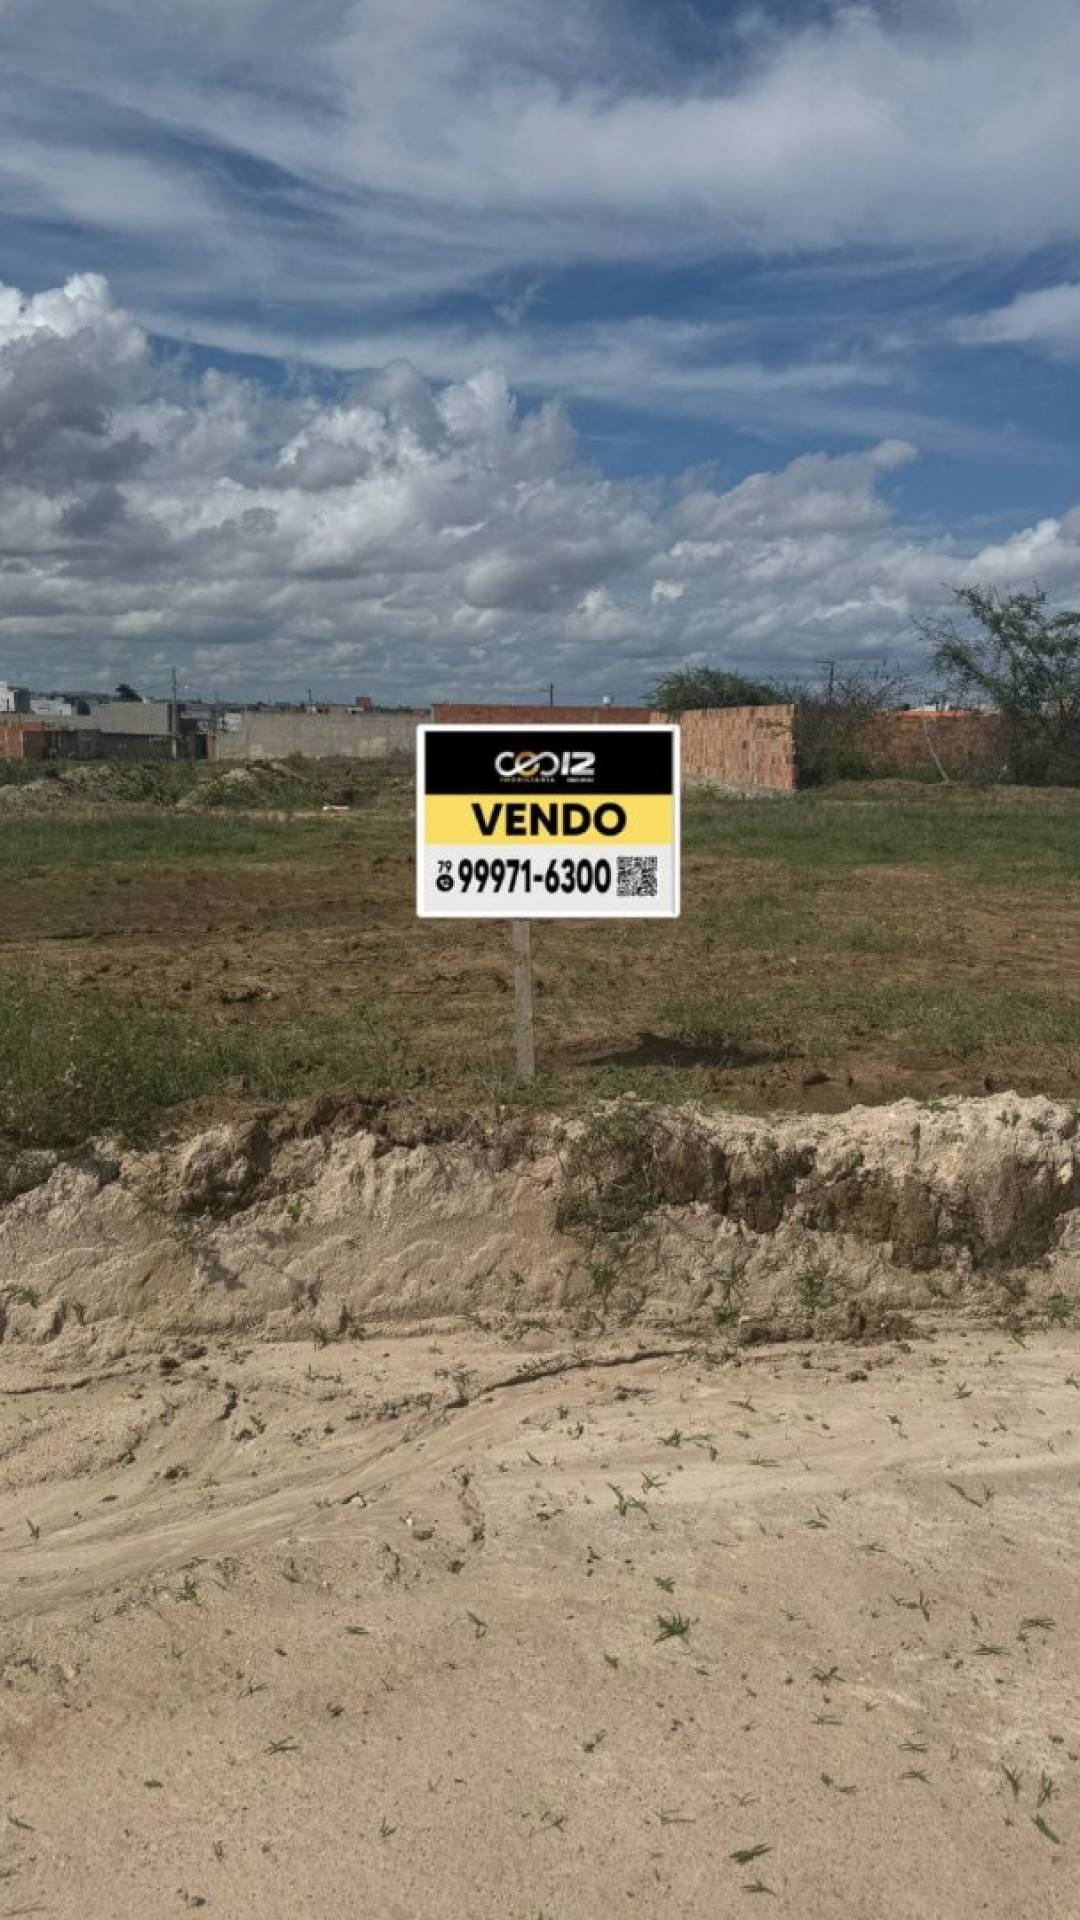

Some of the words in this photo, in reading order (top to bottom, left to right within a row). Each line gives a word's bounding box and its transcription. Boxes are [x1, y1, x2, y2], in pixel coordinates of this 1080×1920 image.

[471, 801, 627, 836] VENDO
[437, 860, 452, 873] 79
[458, 858, 611, 893] 99971-6300
